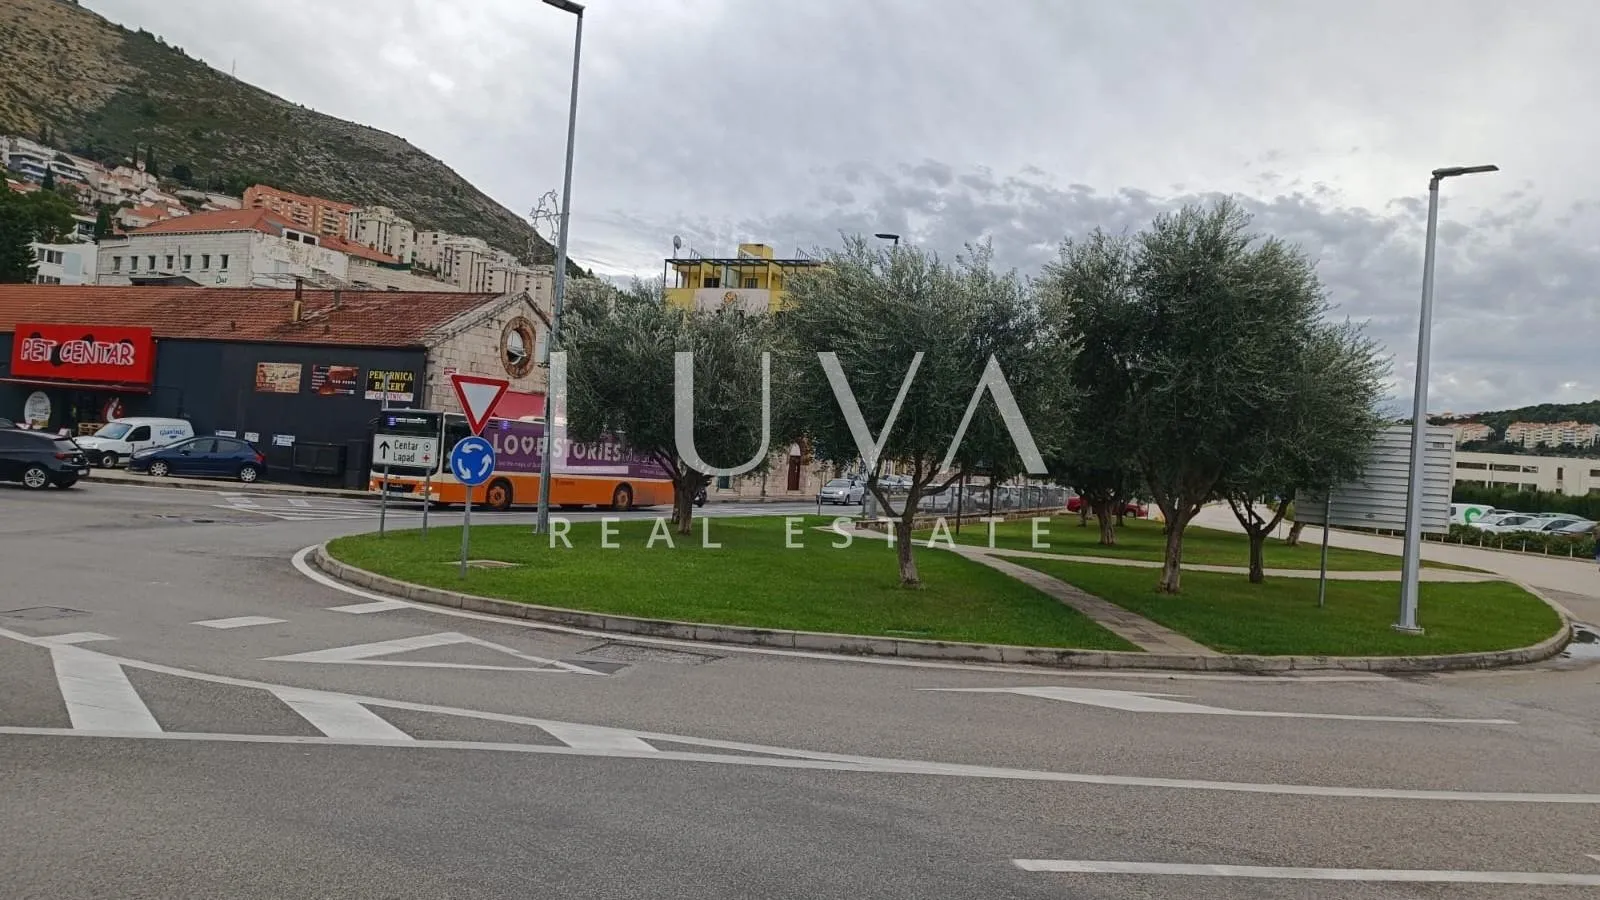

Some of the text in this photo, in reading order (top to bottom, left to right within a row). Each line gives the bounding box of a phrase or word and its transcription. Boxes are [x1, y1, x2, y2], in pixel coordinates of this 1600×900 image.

[21, 338, 134, 365] PET CENTAR
[369, 370, 413, 381] PEKRNICA
[394, 440, 418, 450] Centar
[553, 437, 621, 461] STORIES
[393, 452, 416, 463] Lapad
